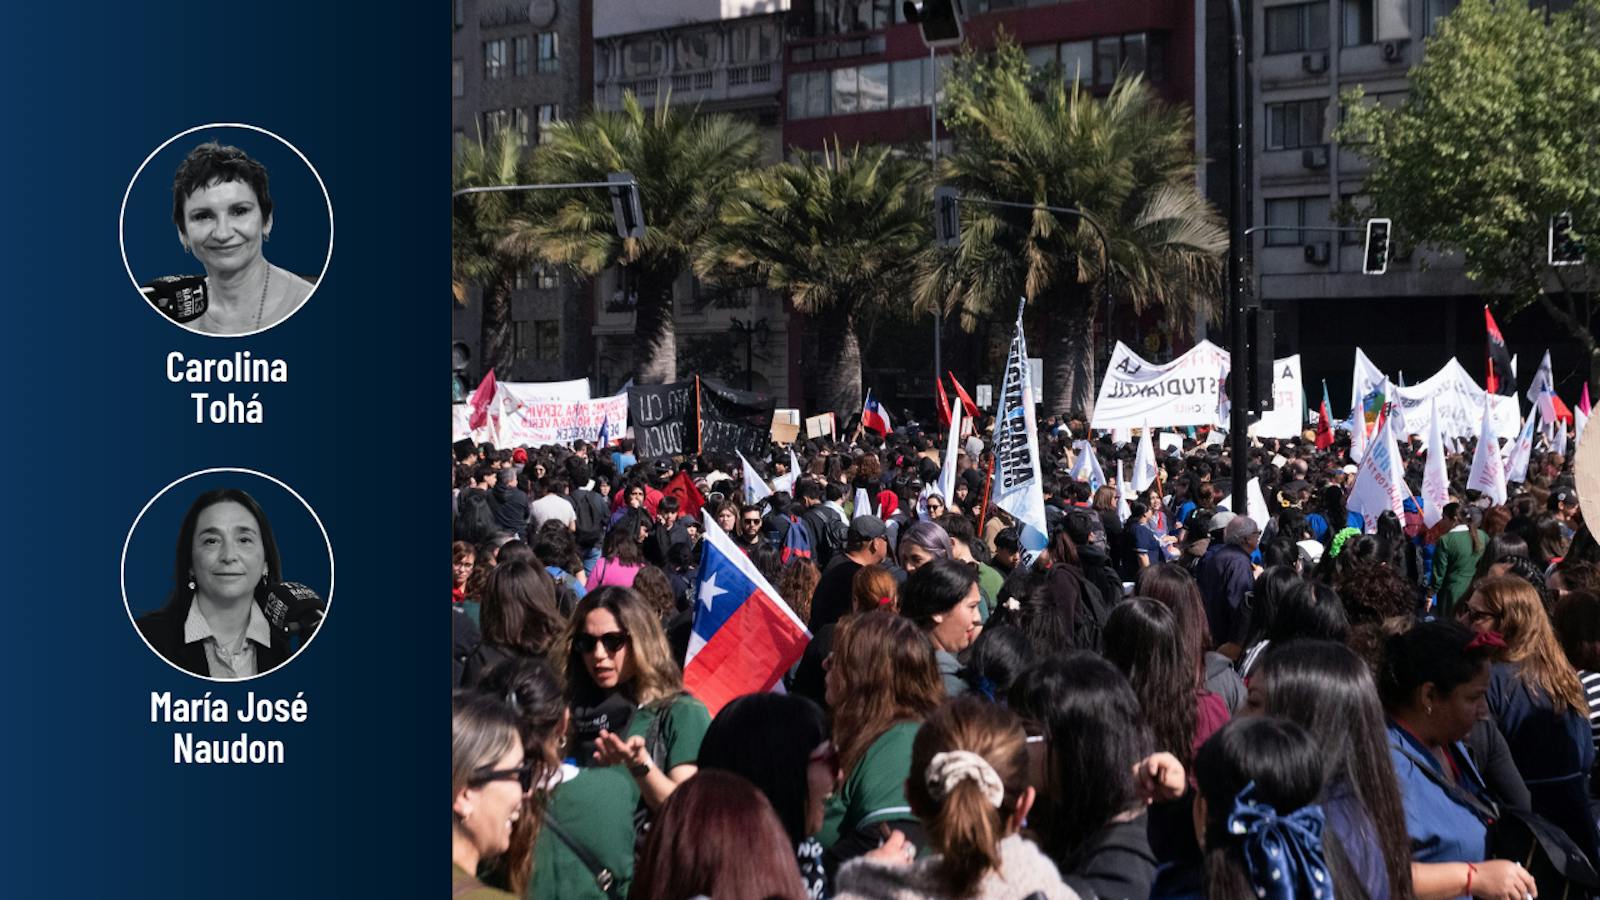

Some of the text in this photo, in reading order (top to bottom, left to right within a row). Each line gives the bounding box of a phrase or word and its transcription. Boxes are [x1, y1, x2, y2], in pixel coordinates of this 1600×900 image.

[182, 287, 192, 317] RADIO
[1005, 335, 1035, 486] TICIA PARA
